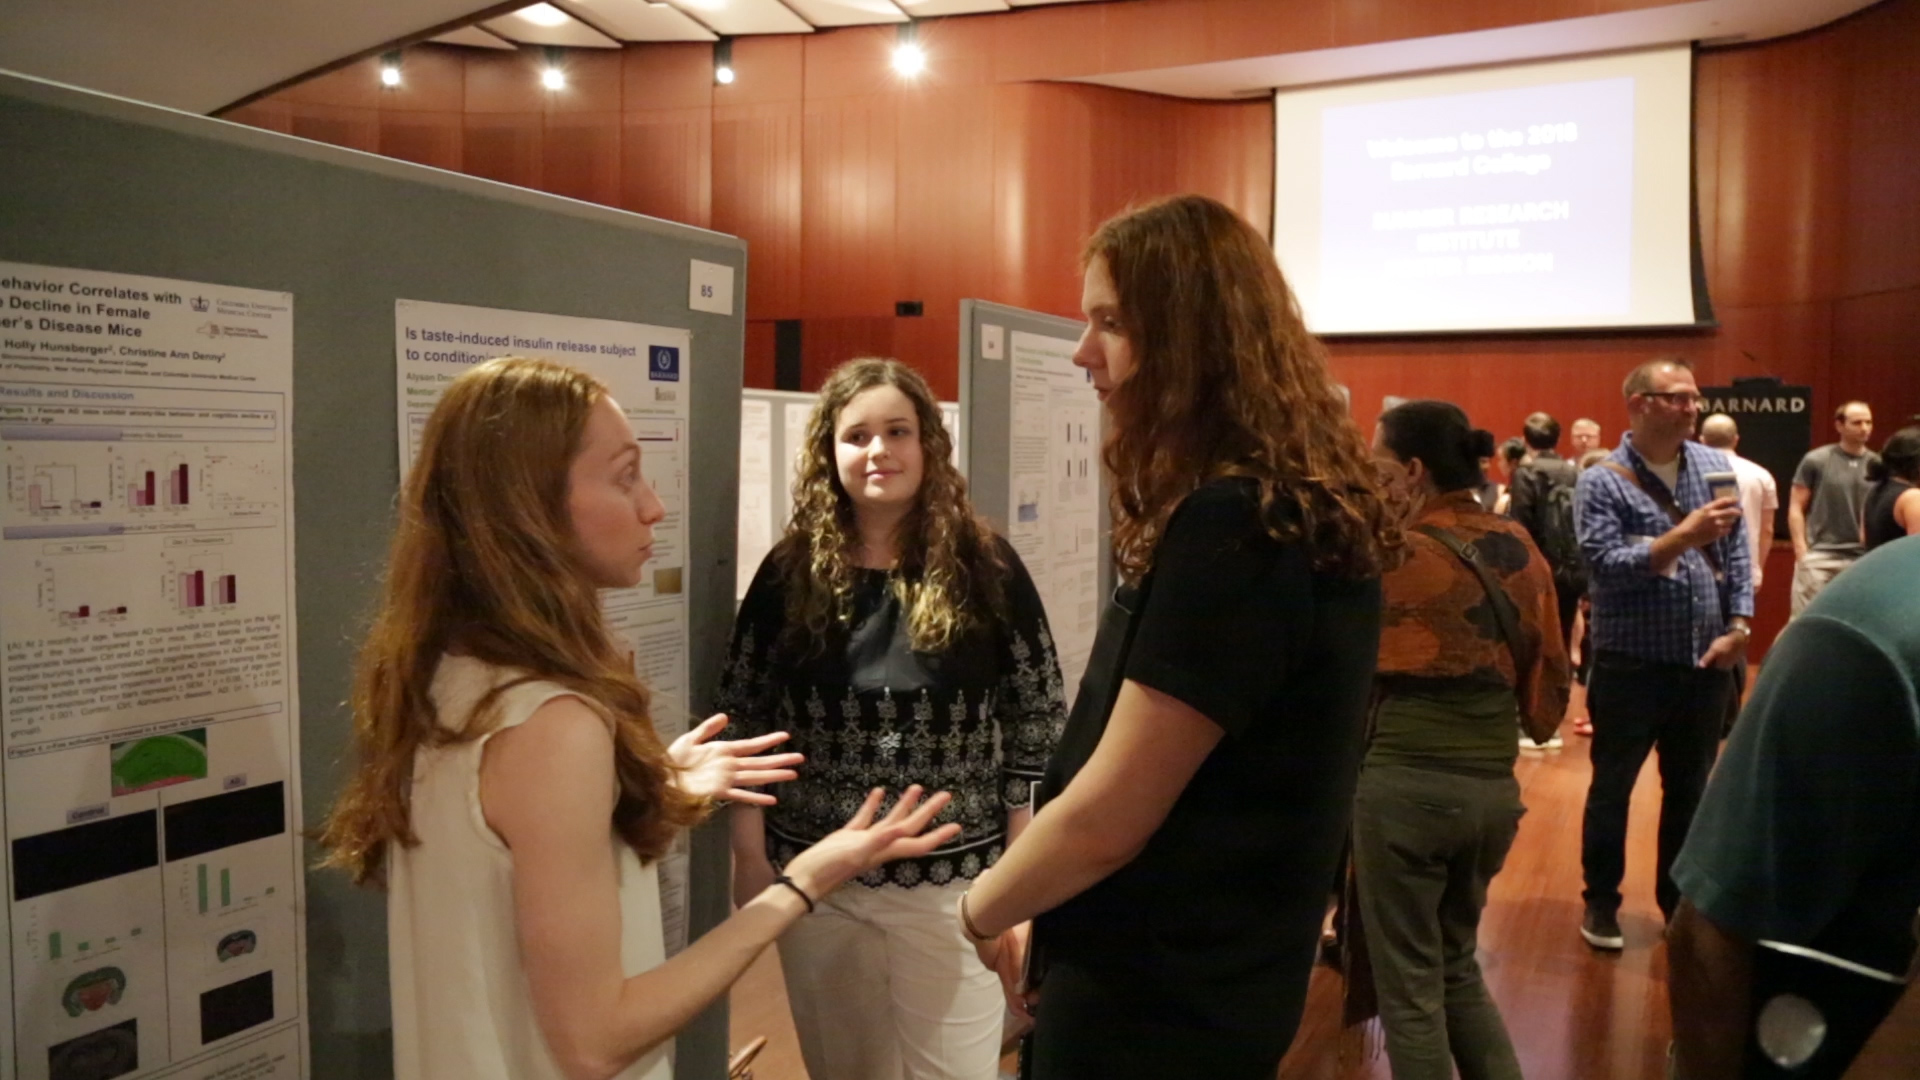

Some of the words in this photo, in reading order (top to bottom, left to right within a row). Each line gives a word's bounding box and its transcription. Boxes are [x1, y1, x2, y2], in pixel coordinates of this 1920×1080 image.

[1459, 200, 1569, 225] RESEARCH
[69, 282, 149, 302] Correlates
[153, 291, 182, 305] with
[701, 284, 713, 298] 85
[9, 296, 71, 314] Decline
[76, 302, 91, 315] in
[95, 303, 151, 320] Female
[39, 318, 103, 335] Disease
[107, 323, 142, 338] Mice
[4, 339, 36, 352] Holly
[119, 346, 167, 358] Christine
[170, 350, 190, 360] Ann
[405, 327, 417, 340] Is
[421, 328, 510, 346] taste-induced
[513, 336, 553, 350] insulin
[556, 340, 597, 354] release
[600, 343, 636, 358] subject
[406, 349, 419, 361] to
[47, 389, 69, 398] and
[72, 390, 135, 401] Discussion
[1699, 397, 1806, 413] BARNARD
[141, 627, 154, 635] AD
